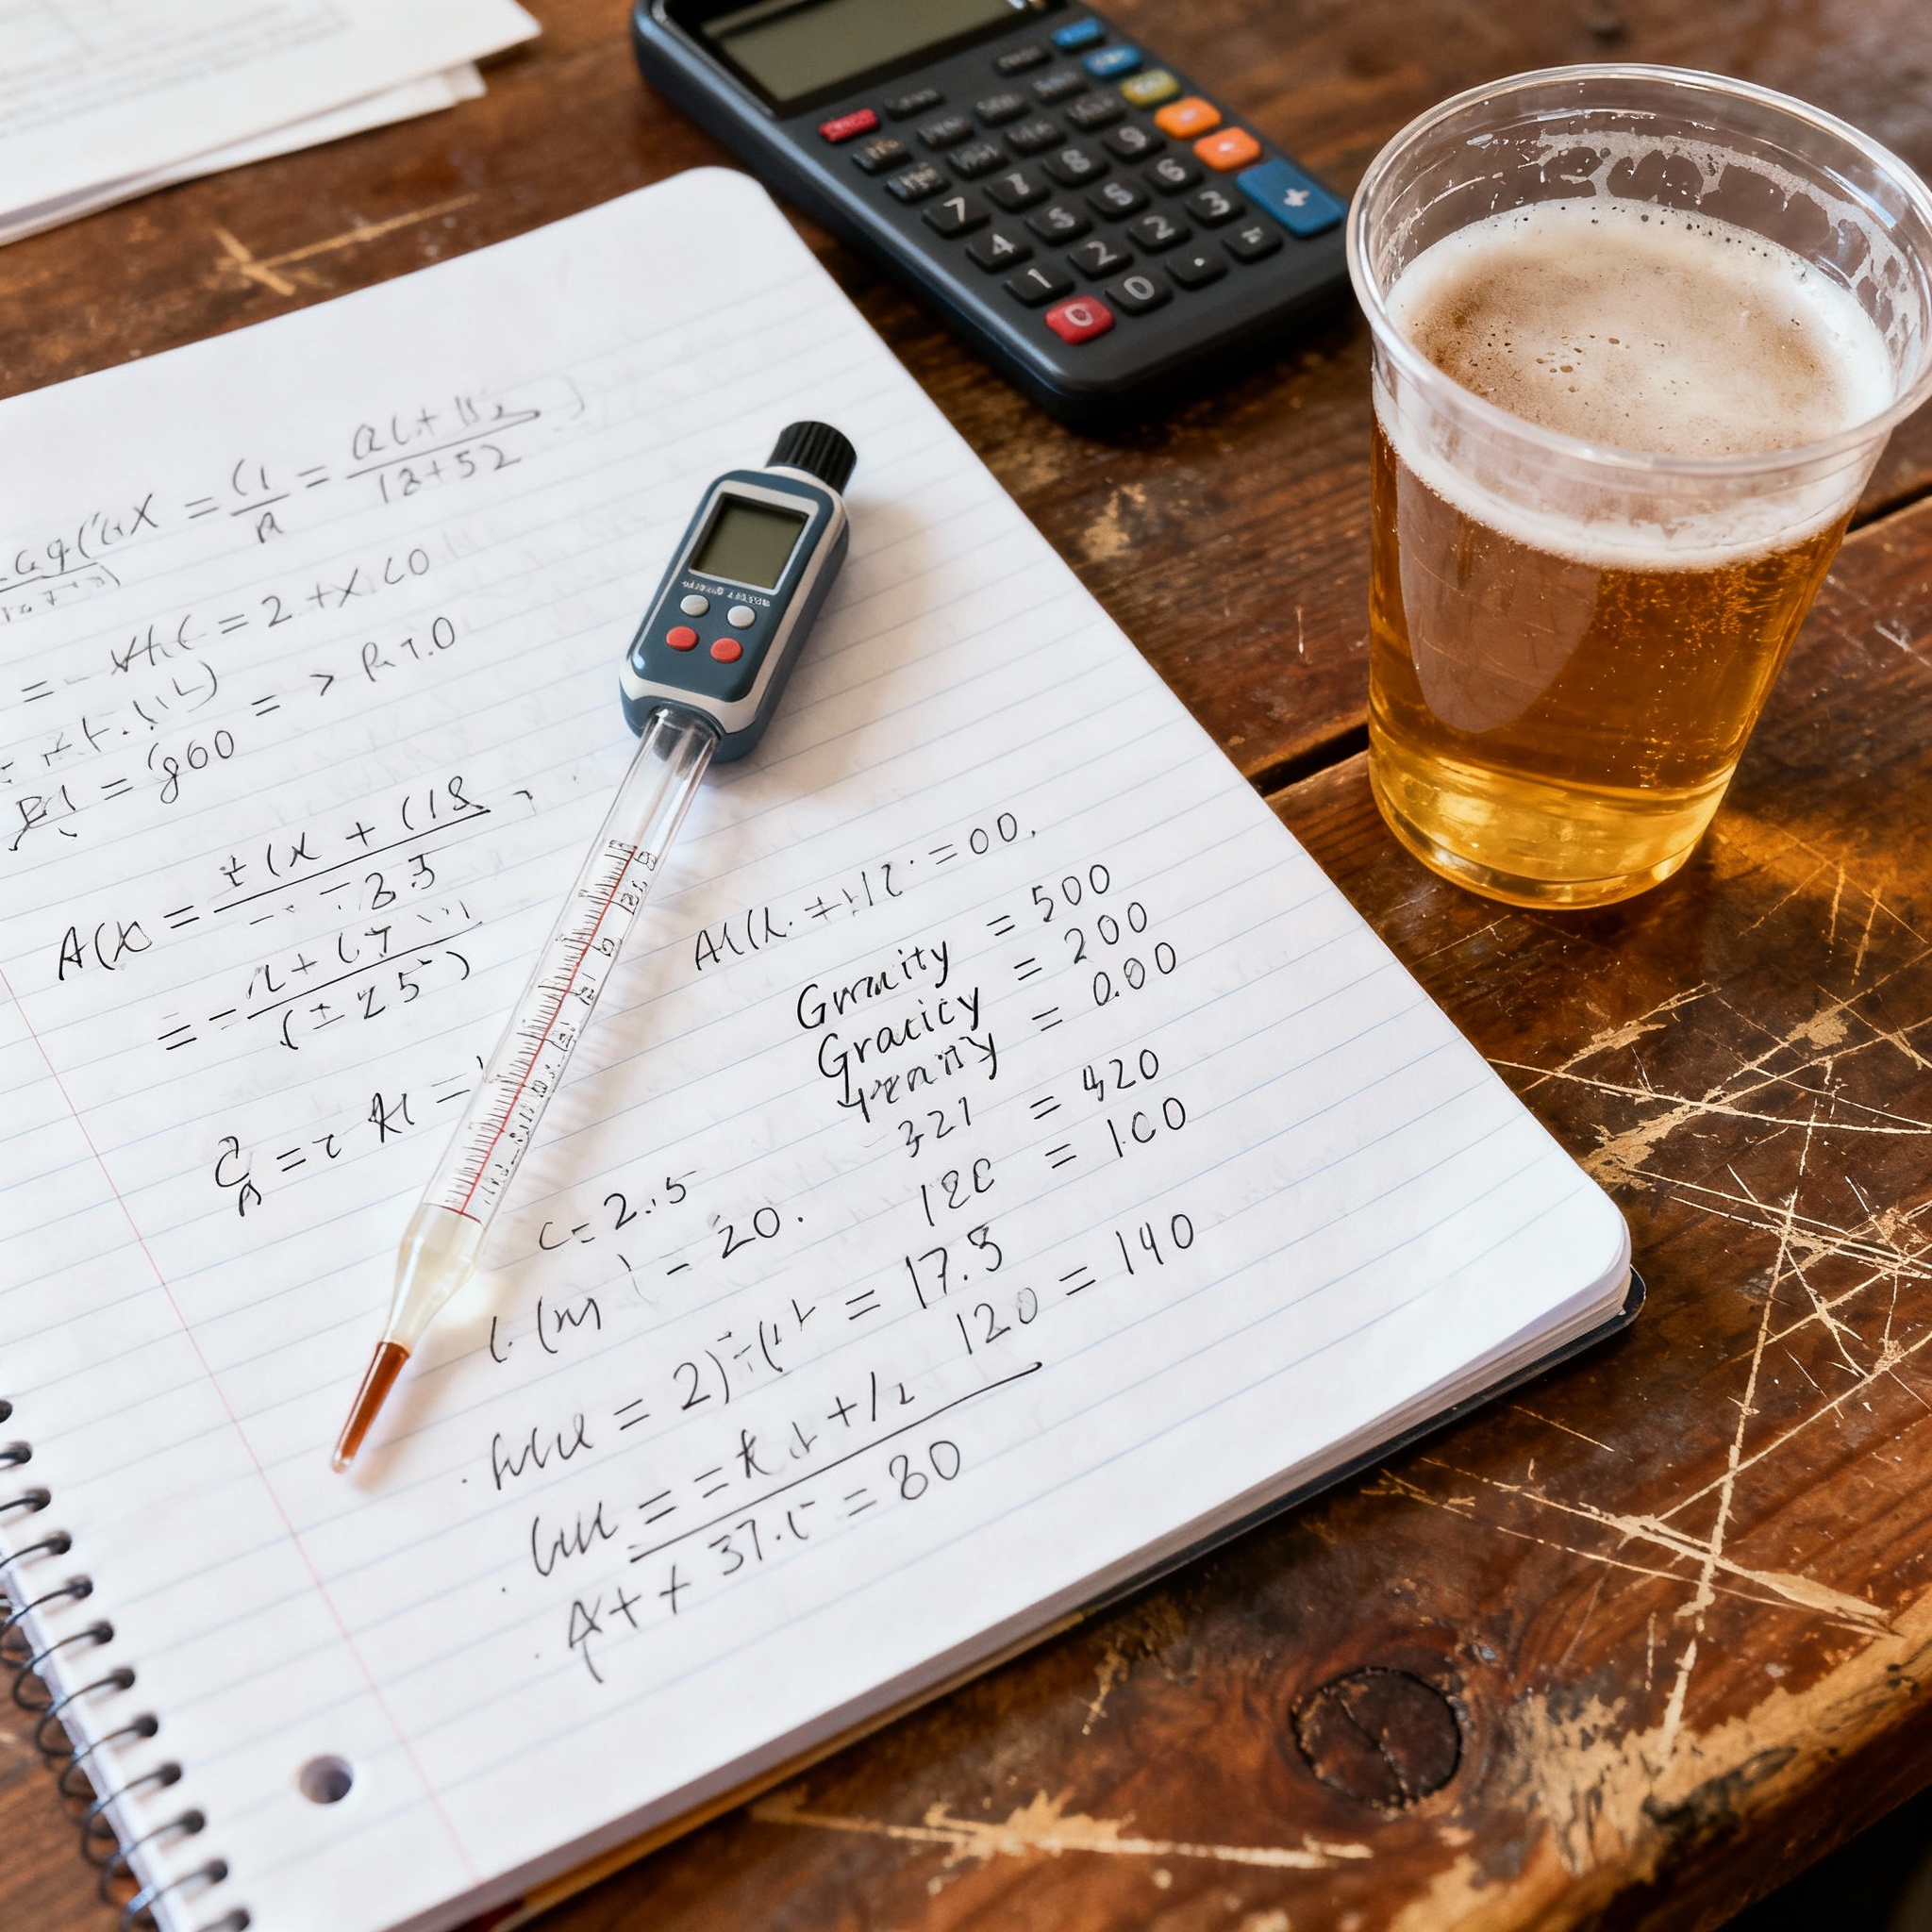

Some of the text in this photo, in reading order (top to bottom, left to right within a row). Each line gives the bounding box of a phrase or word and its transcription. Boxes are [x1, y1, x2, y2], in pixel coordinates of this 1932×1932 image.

[1199, 191, 1231, 216] 3
[1142, 215, 1176, 240] 2
[991, 232, 1017, 256] 4
[1086, 240, 1119, 266] 2
[1026, 268, 1053, 289] 1
[1031, 863, 1110, 923] 500
[1064, 902, 1148, 965] 200
[1115, 1212, 1195, 1274] 140
